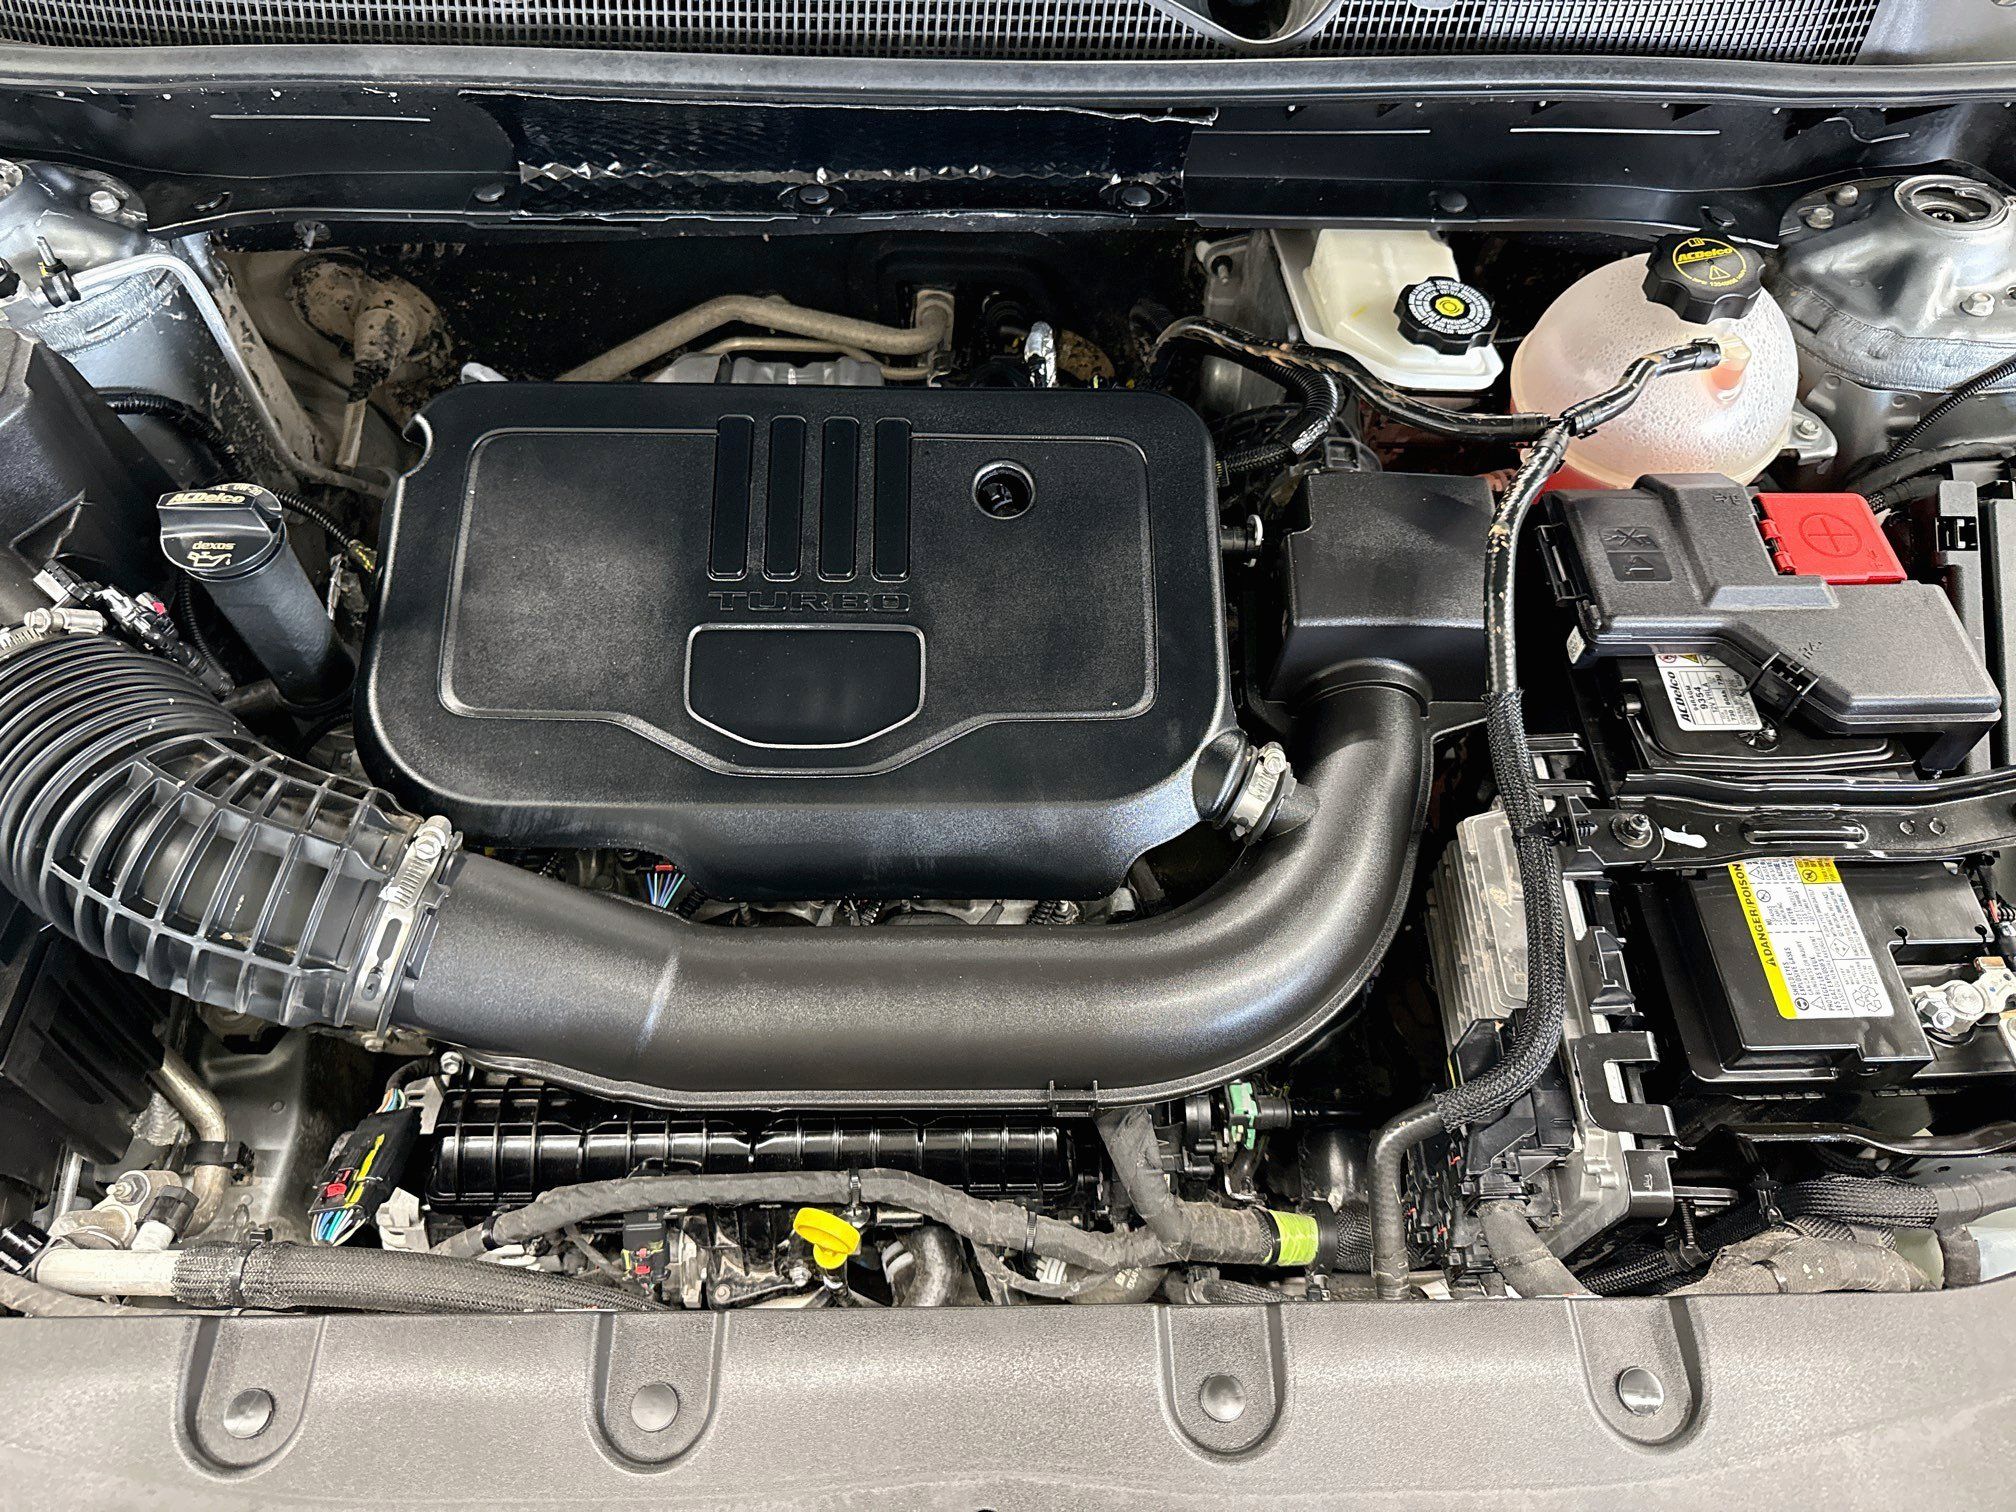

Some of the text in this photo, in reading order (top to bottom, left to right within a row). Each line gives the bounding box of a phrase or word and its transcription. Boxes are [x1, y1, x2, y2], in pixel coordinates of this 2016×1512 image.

[1677, 248, 1733, 262] ACDelco
[166, 492, 245, 504] ACDelco
[192, 541, 236, 550] dexos
[708, 591, 910, 613] TURBO
[1667, 671, 1692, 723] ACDelco
[1693, 687, 1708, 709] 9354
[1732, 863, 1772, 955] DANGER/POISON
[1783, 962, 1792, 975] EYES
